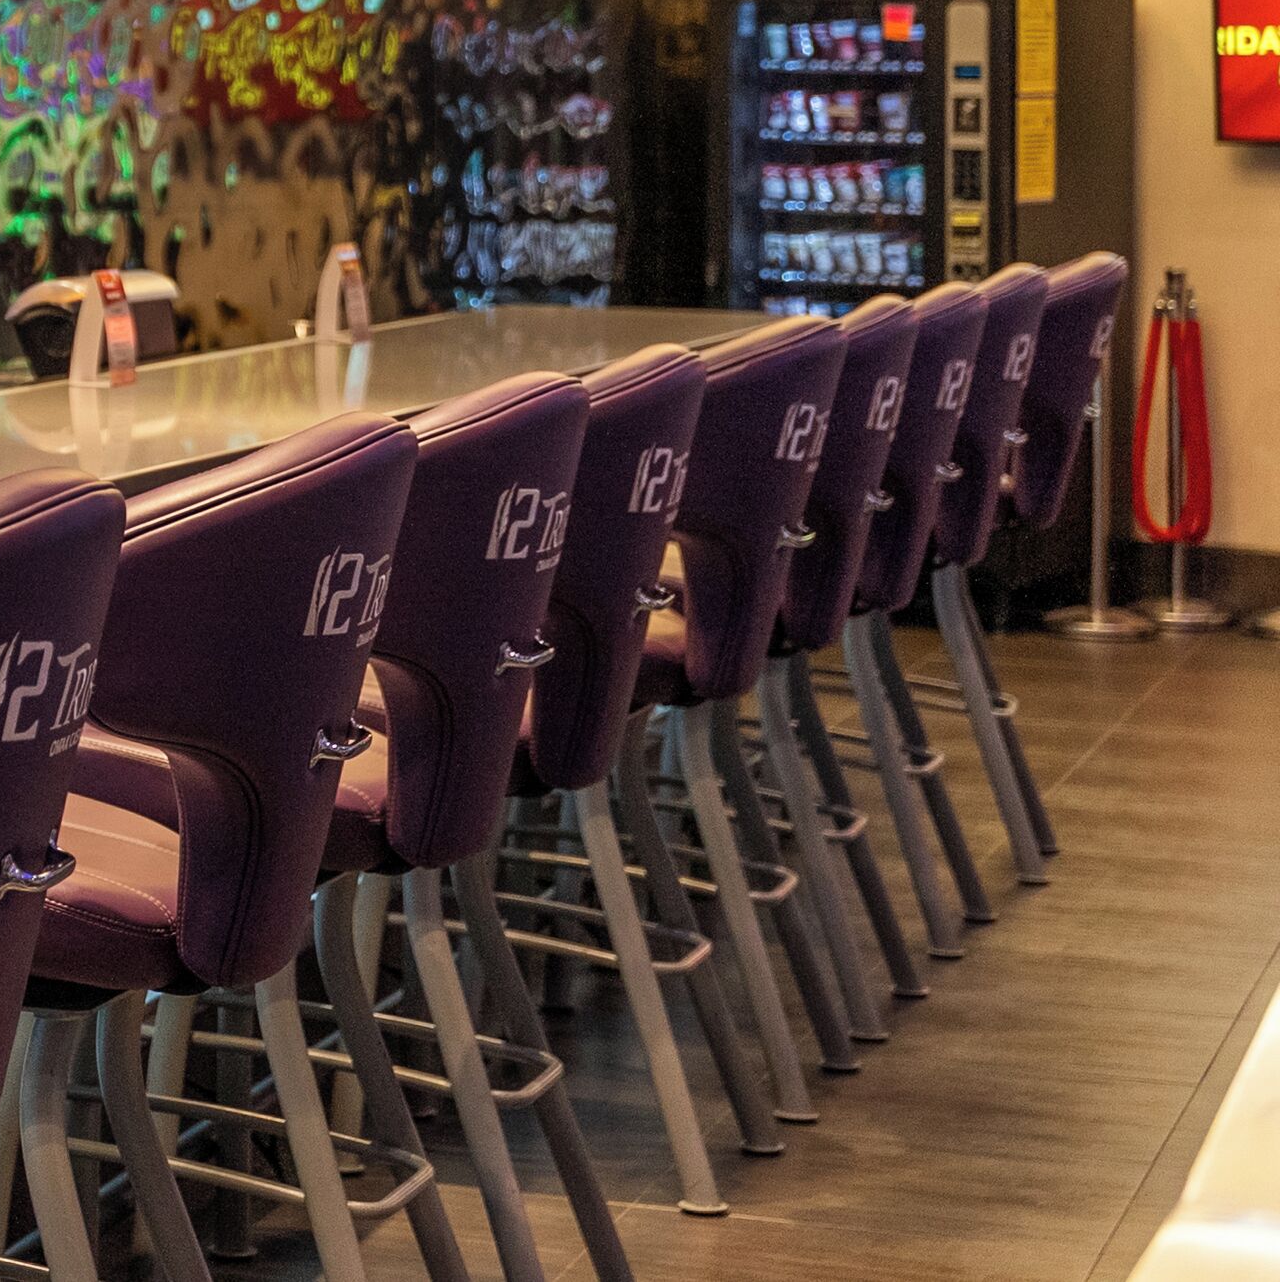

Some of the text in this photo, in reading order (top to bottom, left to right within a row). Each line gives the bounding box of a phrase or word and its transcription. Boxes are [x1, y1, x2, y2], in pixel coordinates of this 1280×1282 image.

[774, 400, 816, 462] 12
[627, 442, 673, 513] 12
[485, 480, 541, 561] 12
[302, 544, 364, 638] 12
